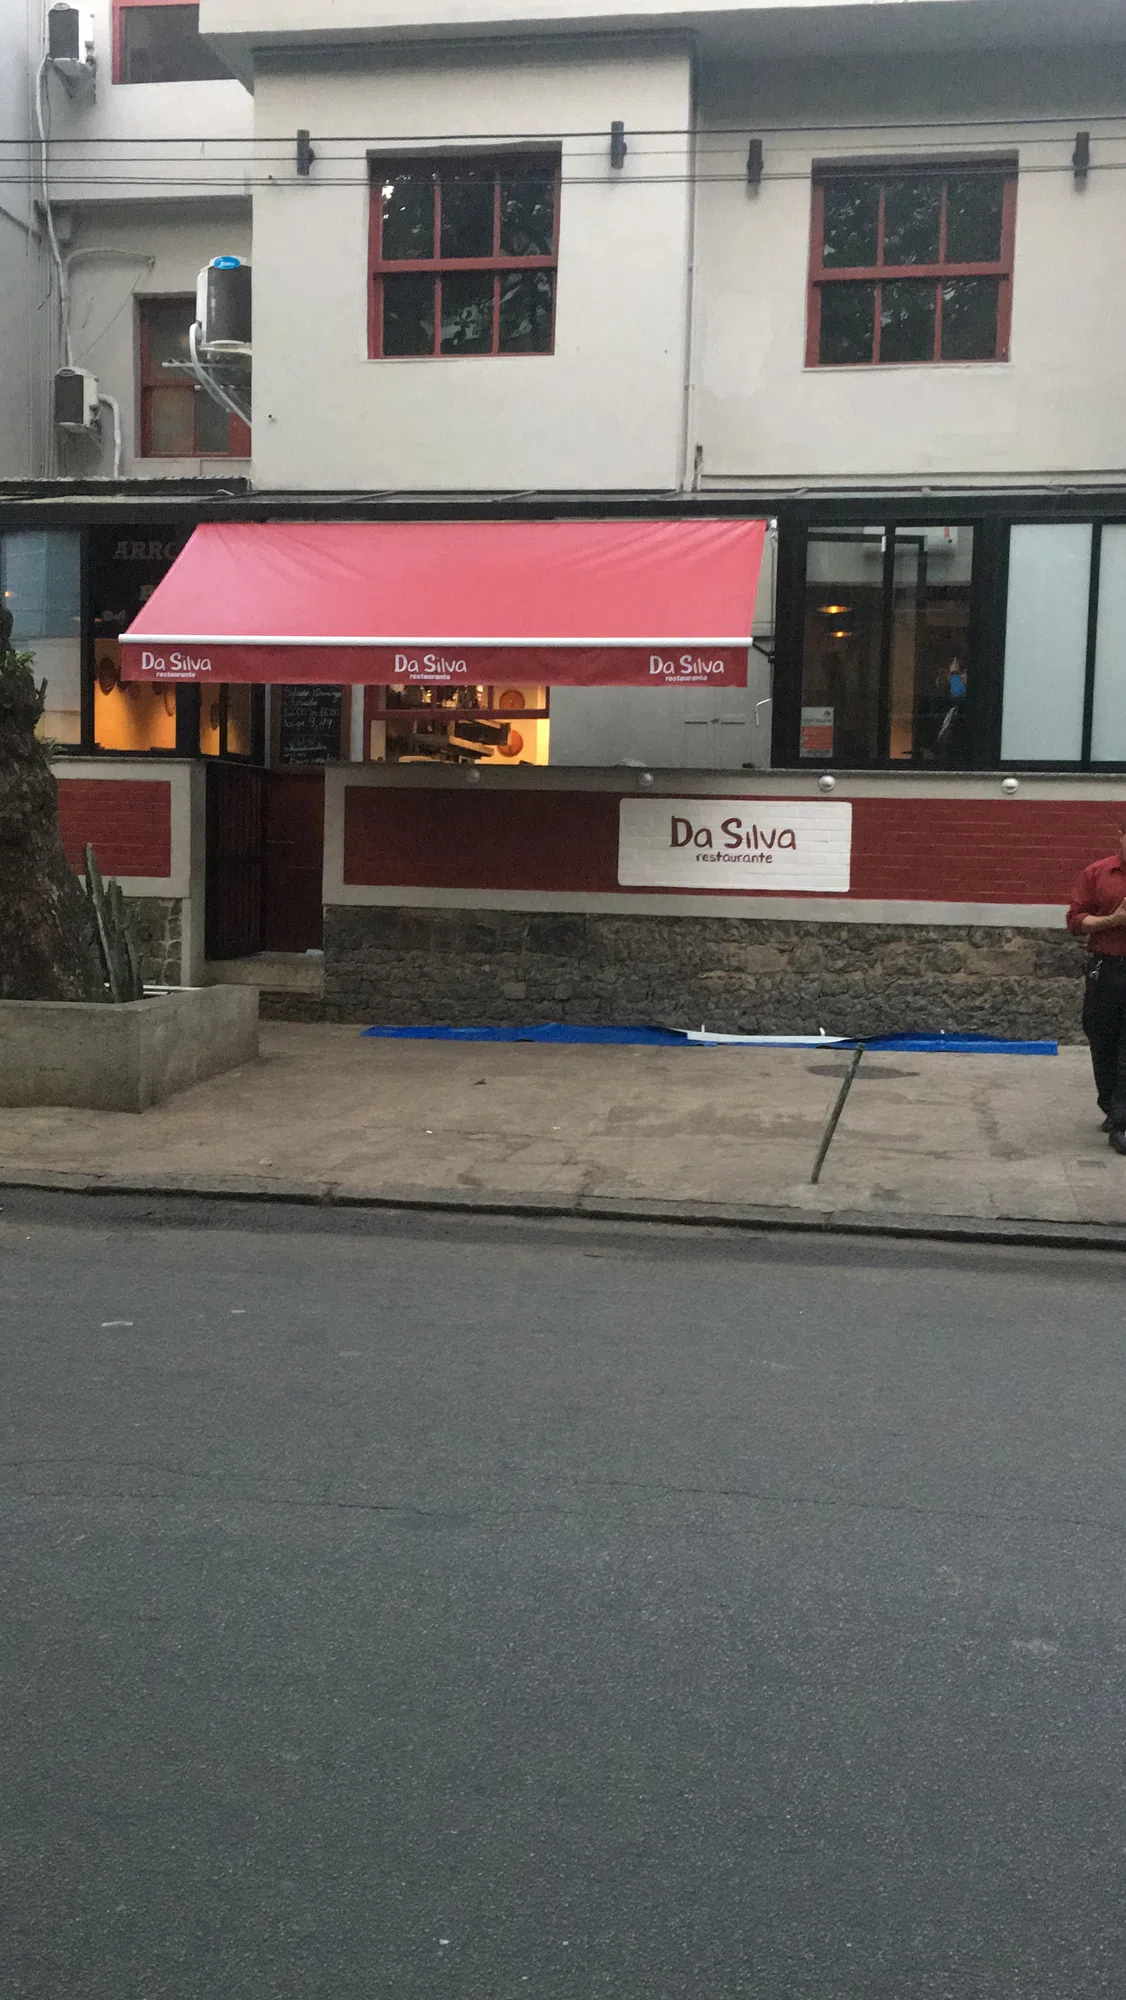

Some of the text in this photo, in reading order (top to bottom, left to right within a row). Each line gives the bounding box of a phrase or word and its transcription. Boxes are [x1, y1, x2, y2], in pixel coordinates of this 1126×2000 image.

[141, 651, 212, 671] Da Silva
[394, 653, 467, 673] Da Silva
[649, 655, 724, 675] Da Silva
[409, 673, 451, 681] restaurante
[669, 815, 797, 850] Da Silva
[696, 851, 773, 863] restaurante
